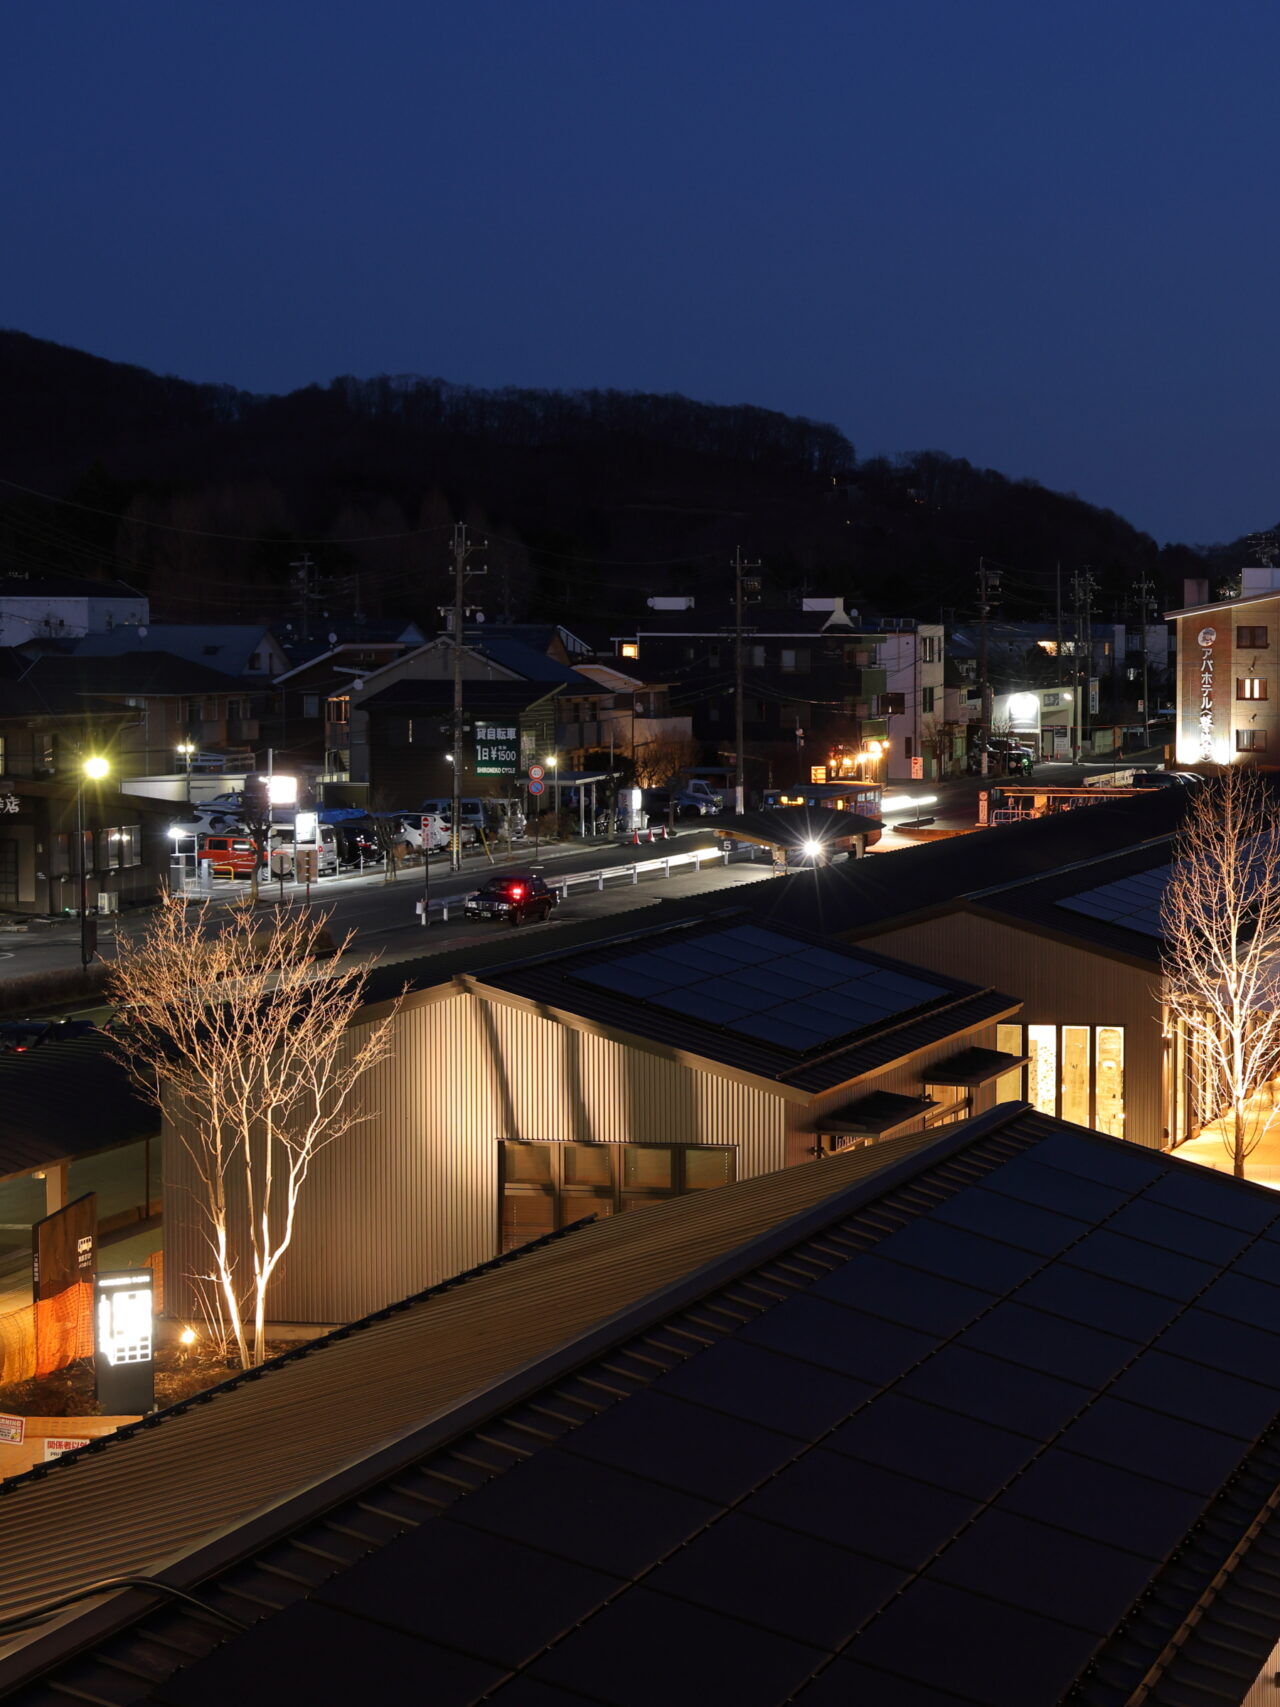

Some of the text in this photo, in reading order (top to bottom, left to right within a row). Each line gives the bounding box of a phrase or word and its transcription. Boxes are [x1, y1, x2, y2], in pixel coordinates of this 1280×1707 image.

[476, 727, 517, 740] 貸自転車
[723, 841, 732, 851] 5
